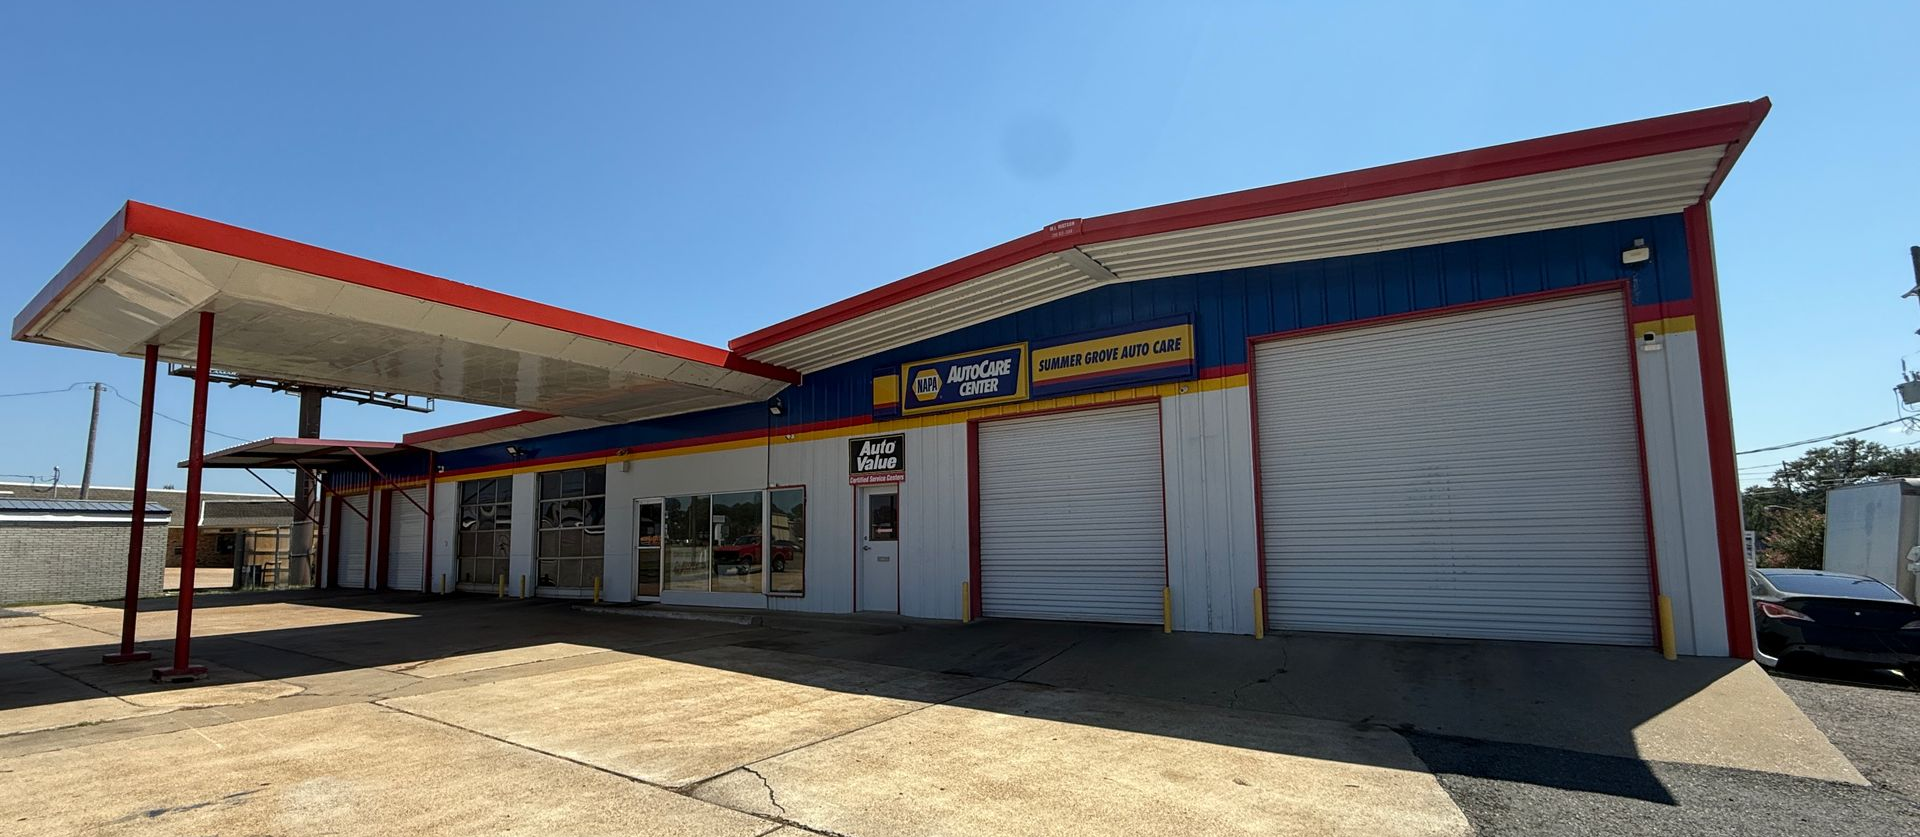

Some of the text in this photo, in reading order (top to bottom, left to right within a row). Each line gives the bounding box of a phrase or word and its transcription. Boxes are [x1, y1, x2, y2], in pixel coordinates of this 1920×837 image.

[1038, 337, 1182, 372] SUMMER GROVE AUTO CARE
[917, 376, 938, 394] NAPA
[959, 377, 999, 397] CENTER
[859, 439, 896, 457] Auto
[857, 454, 897, 472] Value
[850, 475, 870, 484] Certified
[870, 475, 886, 483] Service
